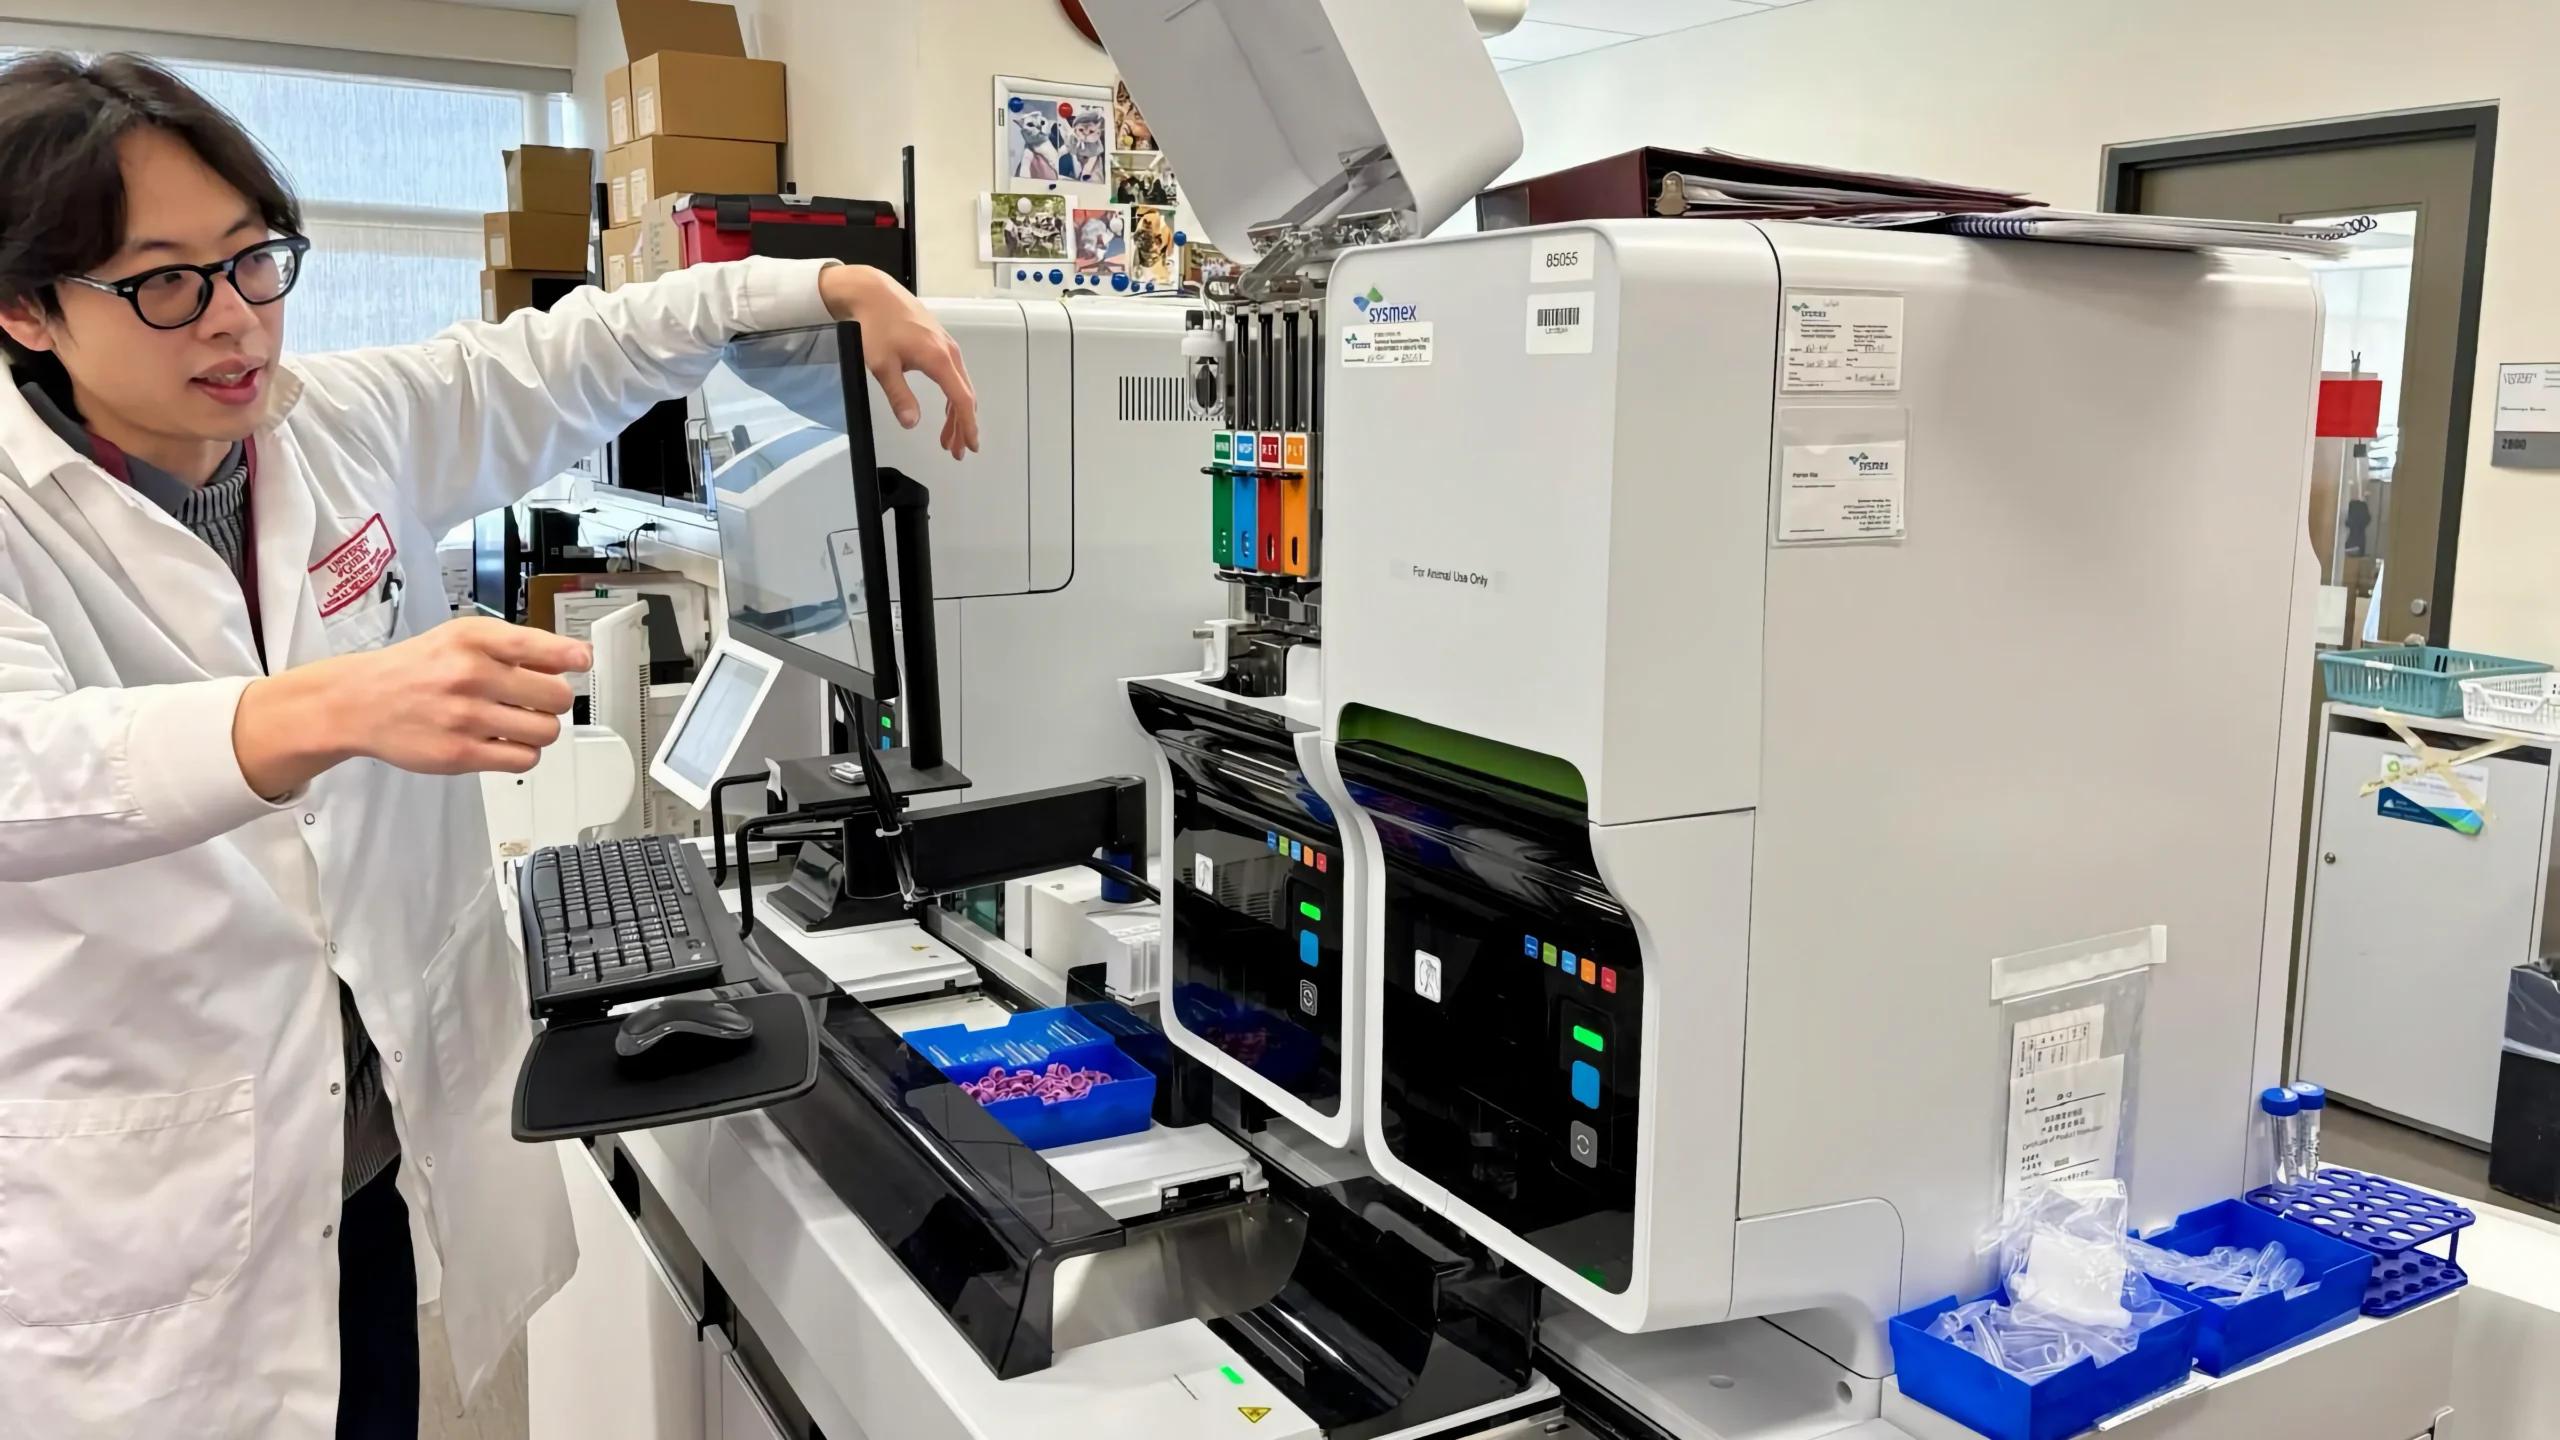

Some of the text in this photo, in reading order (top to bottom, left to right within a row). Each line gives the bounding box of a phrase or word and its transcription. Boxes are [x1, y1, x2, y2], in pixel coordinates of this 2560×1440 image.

[1546, 251, 1578, 268] 85055
[1369, 305, 1417, 323] sysmex
[1262, 444, 1278, 456] RET
[1287, 444, 1304, 457] PLT
[327, 535, 370, 574] UNIVERSITY
[1413, 565, 1489, 588] For Animal Use Only
